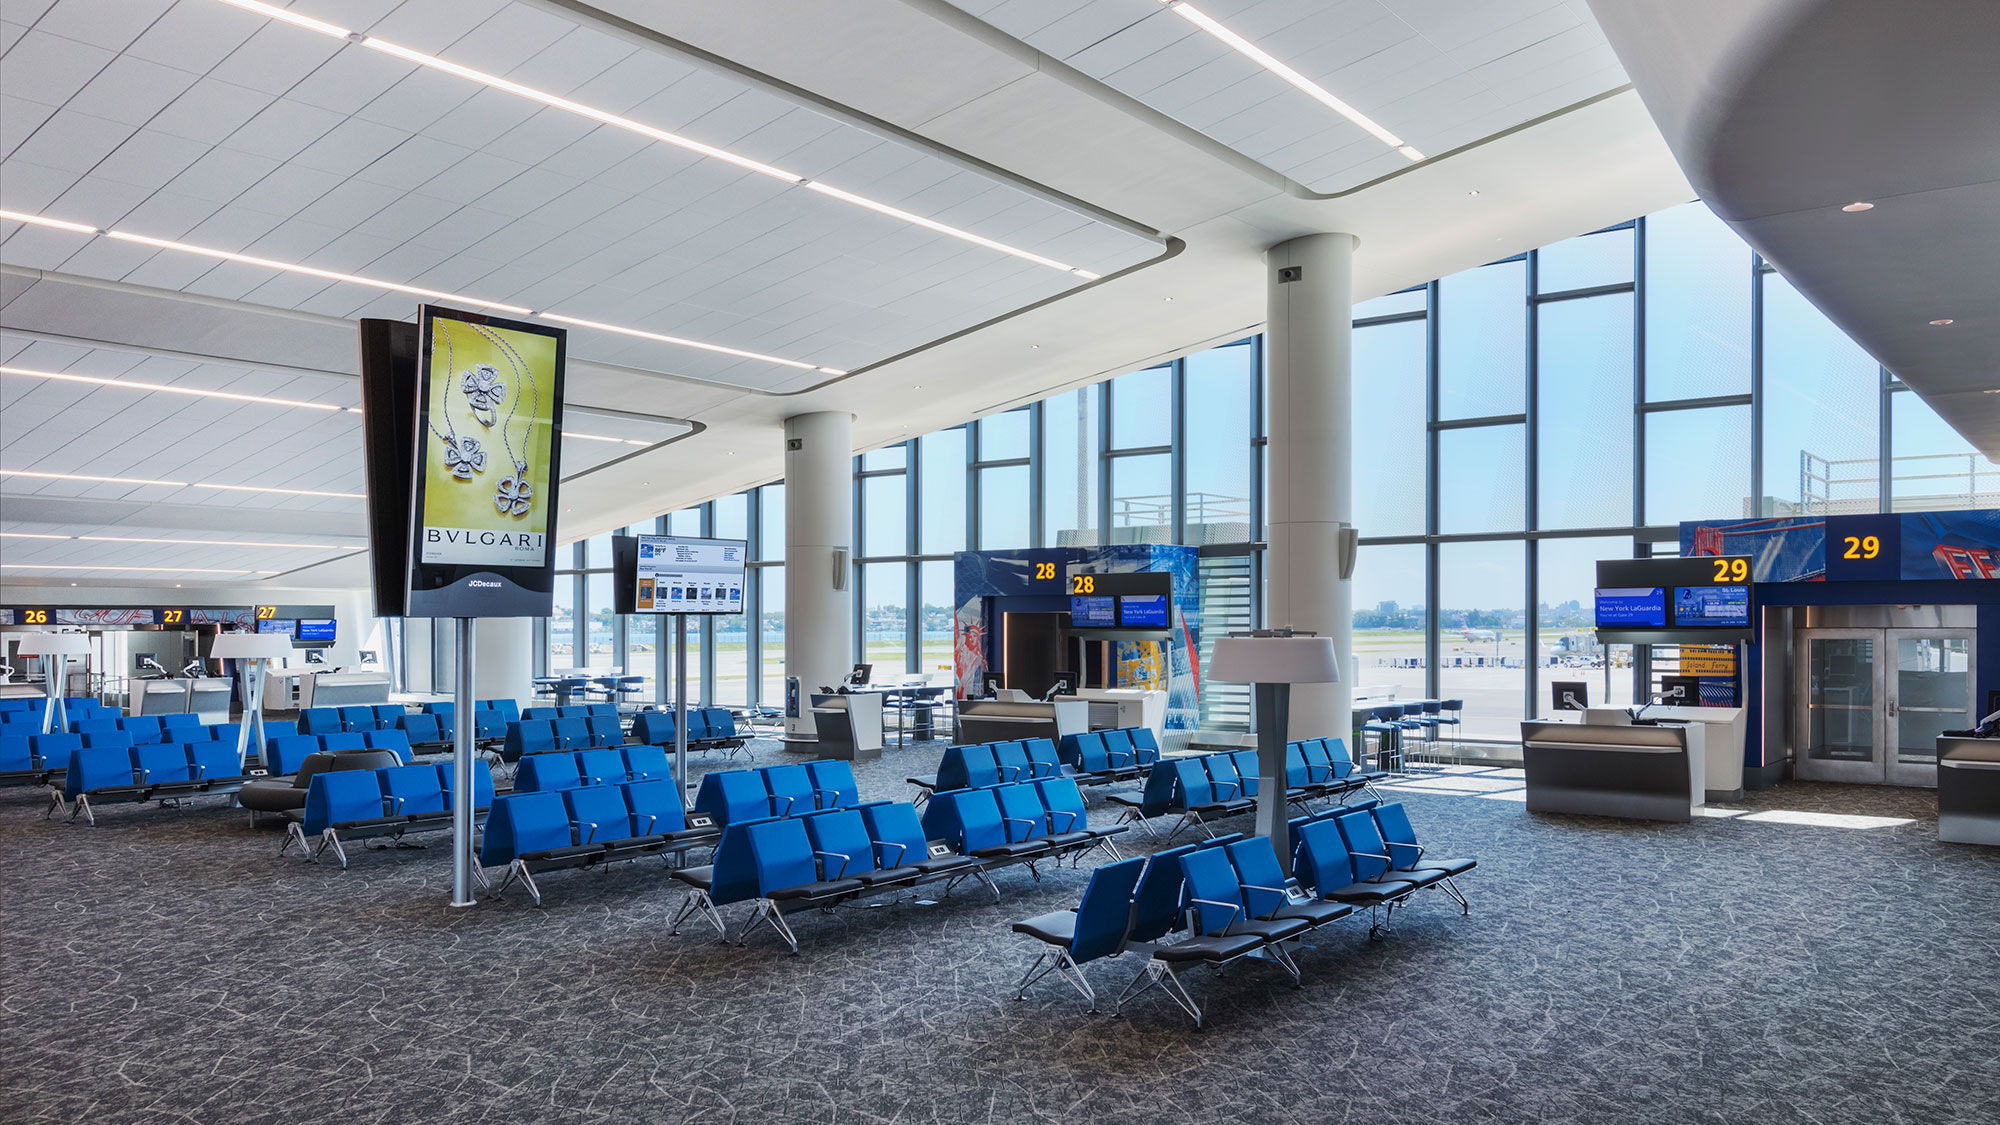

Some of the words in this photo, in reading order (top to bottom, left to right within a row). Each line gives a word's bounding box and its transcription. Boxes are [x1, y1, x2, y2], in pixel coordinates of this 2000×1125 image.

[427, 529, 543, 548] BVLGARI
[1842, 535, 1880, 560] 29
[1035, 562, 1056, 580] 28
[1713, 558, 1748, 582] 29
[468, 580, 502, 588] JCDecaux
[1073, 575, 1095, 594] 28
[25, 610, 47, 624] 26
[163, 610, 182, 623] 27
[258, 606, 277, 619] 27
